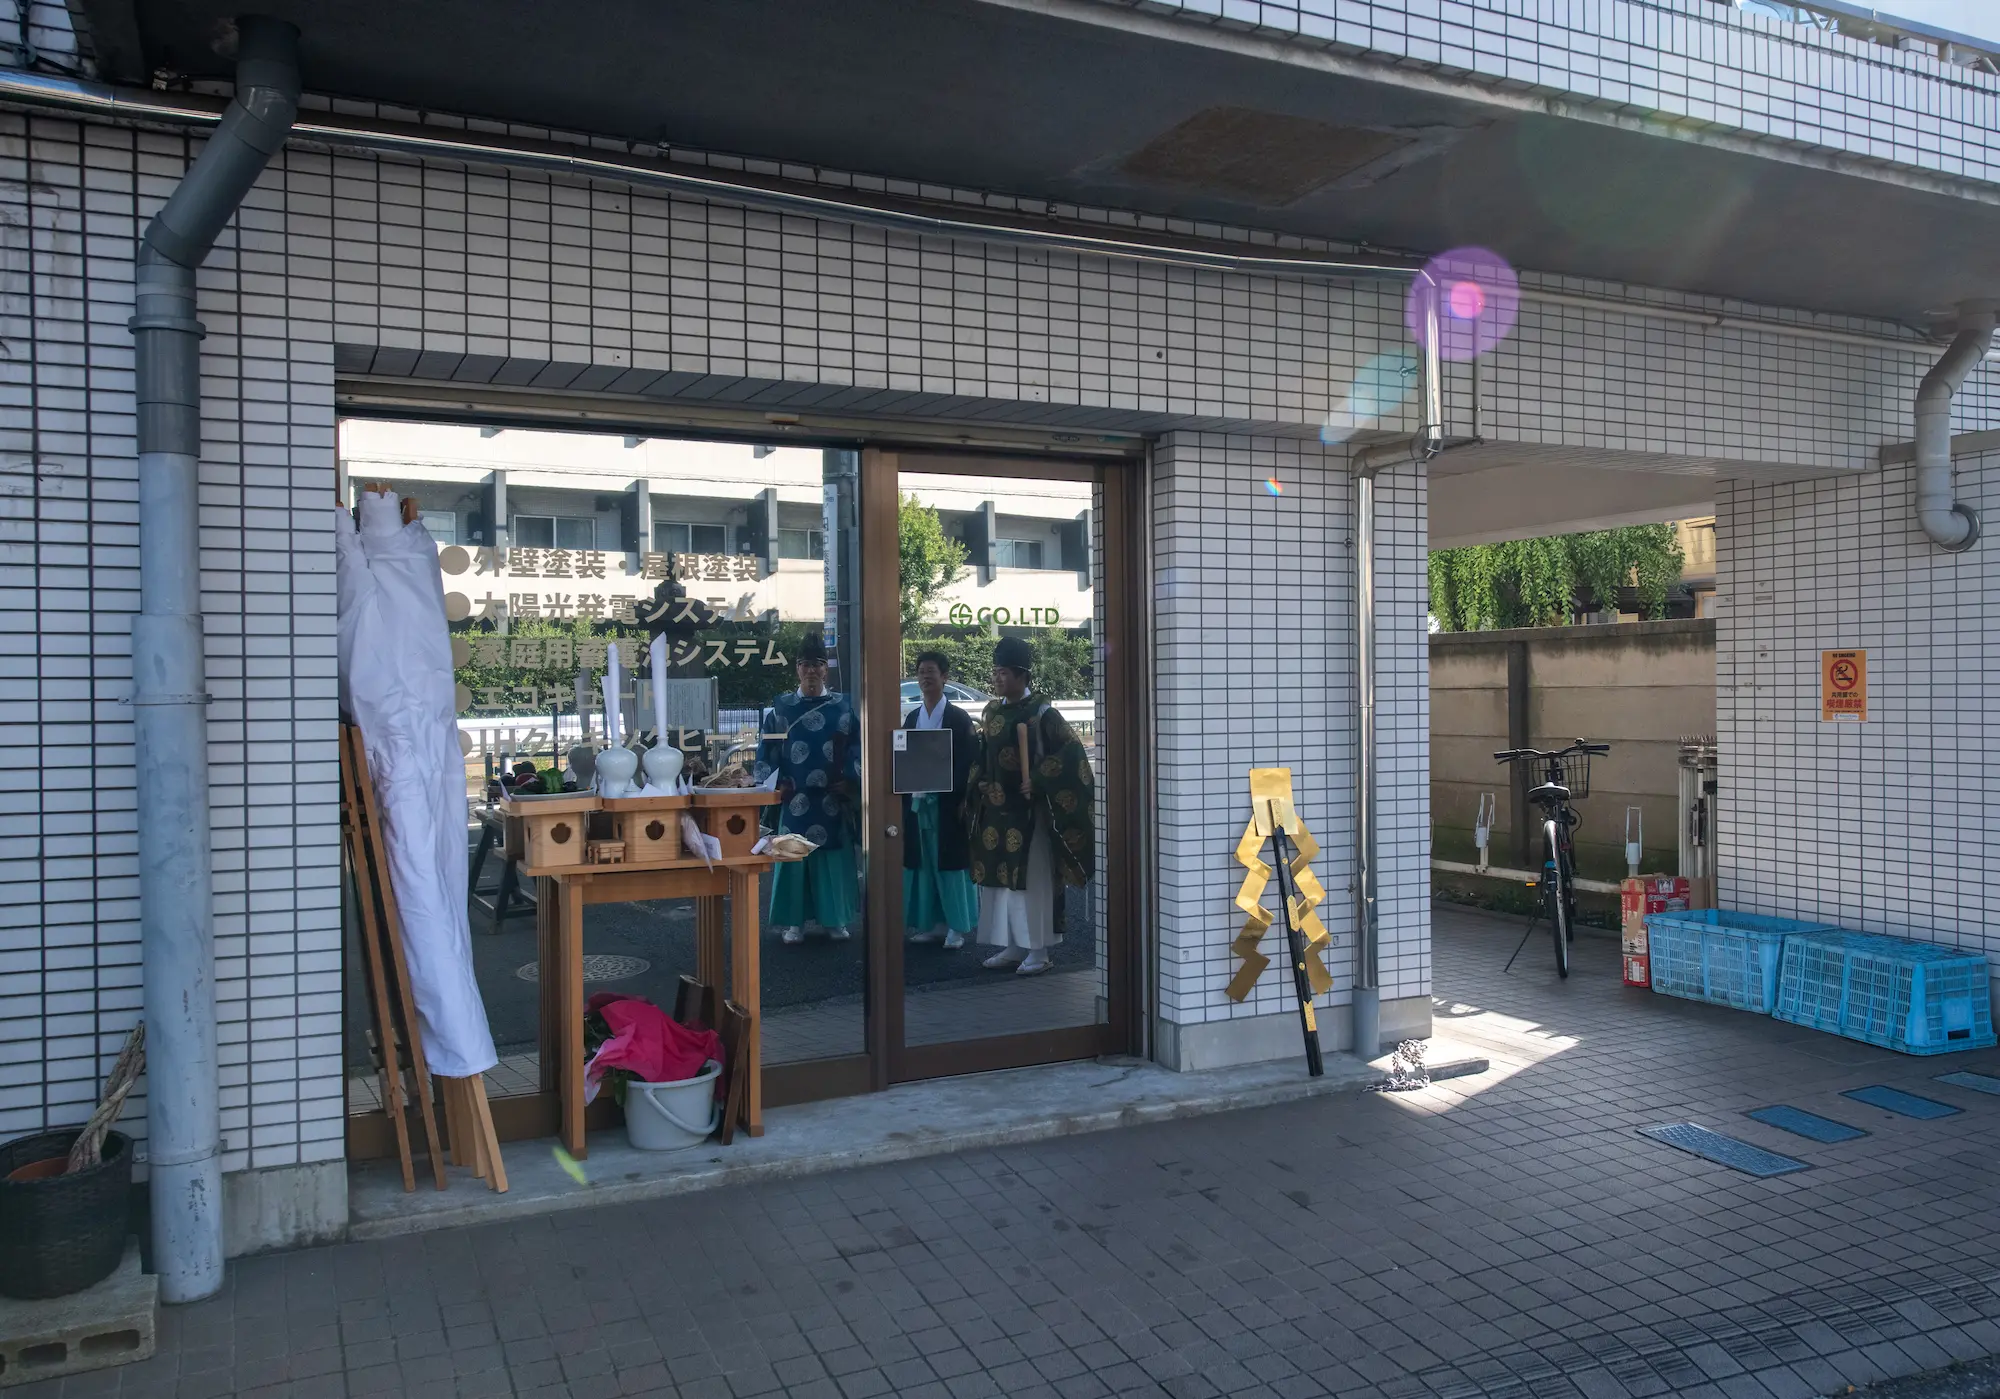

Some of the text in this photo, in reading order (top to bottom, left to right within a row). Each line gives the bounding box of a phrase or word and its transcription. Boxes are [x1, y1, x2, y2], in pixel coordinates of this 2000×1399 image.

[474, 547, 761, 582] 外壁塗装・屋根塗装
[474, 591, 759, 625] 太陽光発電システム
[977, 607, 1061, 625] CO.LTD
